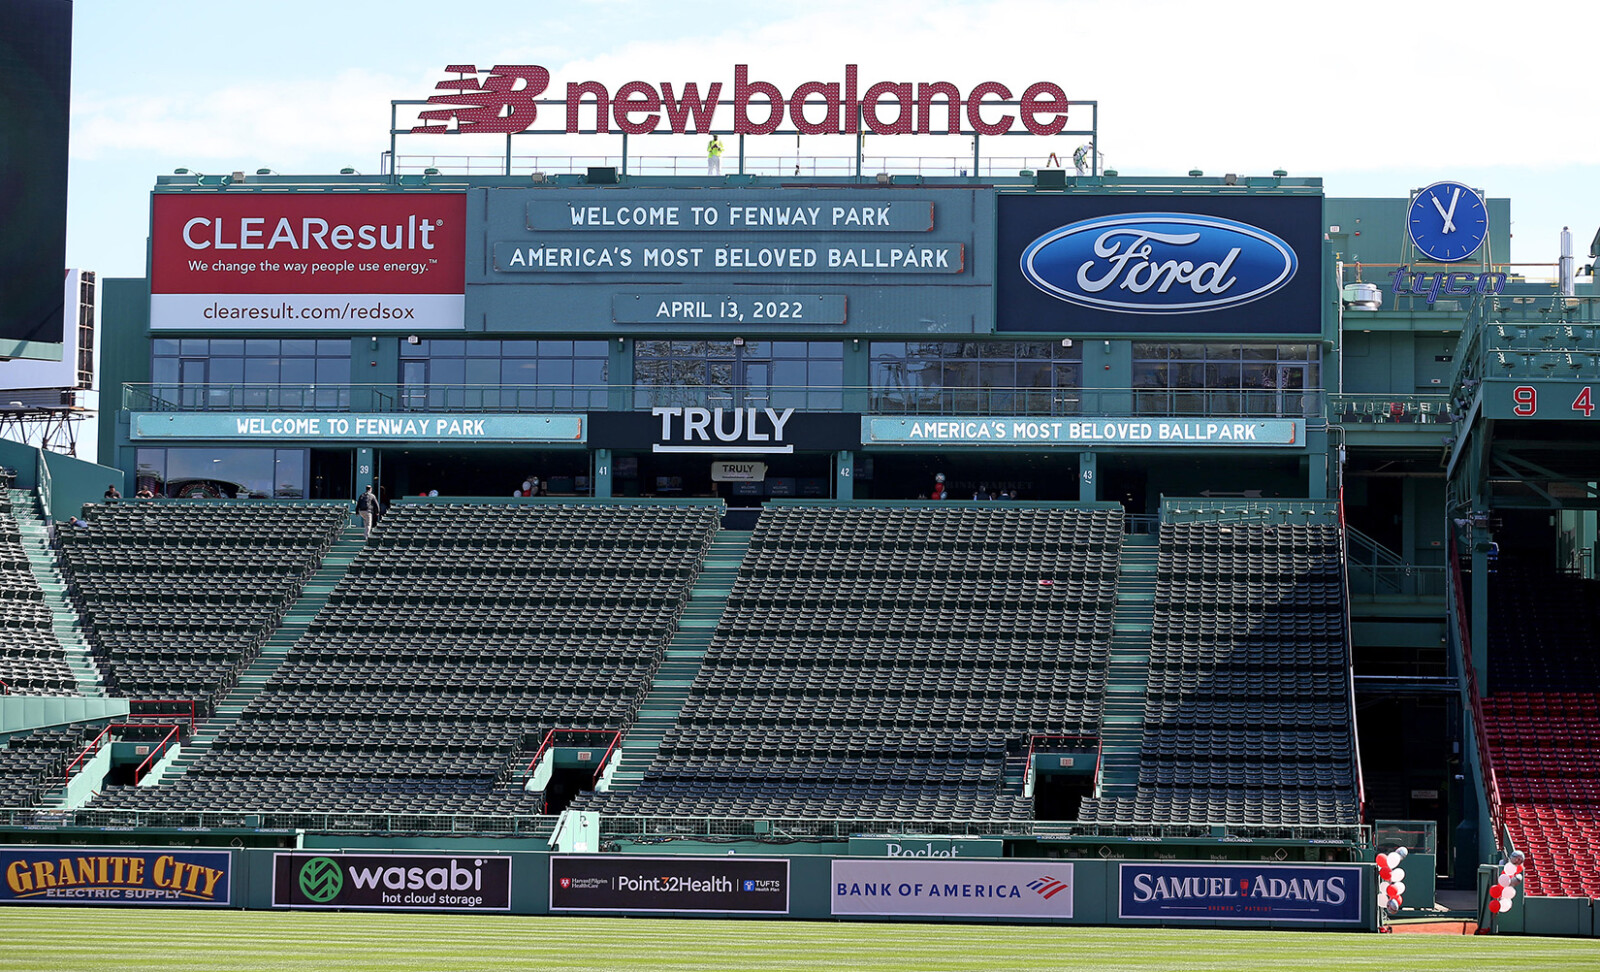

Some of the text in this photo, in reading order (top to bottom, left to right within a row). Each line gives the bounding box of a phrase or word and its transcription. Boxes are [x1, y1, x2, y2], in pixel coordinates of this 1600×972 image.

[566, 80, 722, 135] new
[734, 64, 1069, 136] balance
[570, 207, 890, 226] WELCOME TO FENWAY PARK
[510, 248, 949, 268] AMERICA'S MOST BELOVED BALLPARK
[1077, 229, 1241, 293] Ford
[188, 261, 208, 272] We
[212, 261, 256, 275] change
[260, 261, 278, 272] the
[283, 263, 308, 275] way
[312, 261, 354, 275] people
[359, 263, 379, 272] use
[1388, 266, 1508, 304] tyco
[203, 302, 415, 321] clearesult.com/redsox
[656, 301, 803, 322] APRIL 13, 2022
[1513, 386, 1595, 417] 9 4
[237, 418, 484, 435] WELCOME TO FENWAY PARK
[652, 407, 795, 441] TRULY
[910, 422, 1256, 440] AMERICA'S MOST BELOVED BALLPARK
[360, 465, 369, 475] 39
[599, 466, 607, 476] 41
[841, 468, 849, 477] 42
[1083, 470, 1093, 479] 43
[886, 843, 958, 857] Rocket
[6, 855, 223, 896] GRANITE CITY
[349, 859, 482, 891] wasabi
[618, 876, 732, 892] Point32Health
[46, 888, 181, 898] ELECTRIC SUPPLY
[837, 883, 1021, 898] BANK OF AMERICA
[1133, 873, 1346, 905] SAMUEL ADAMS
[382, 892, 482, 906] hot cloud storage
